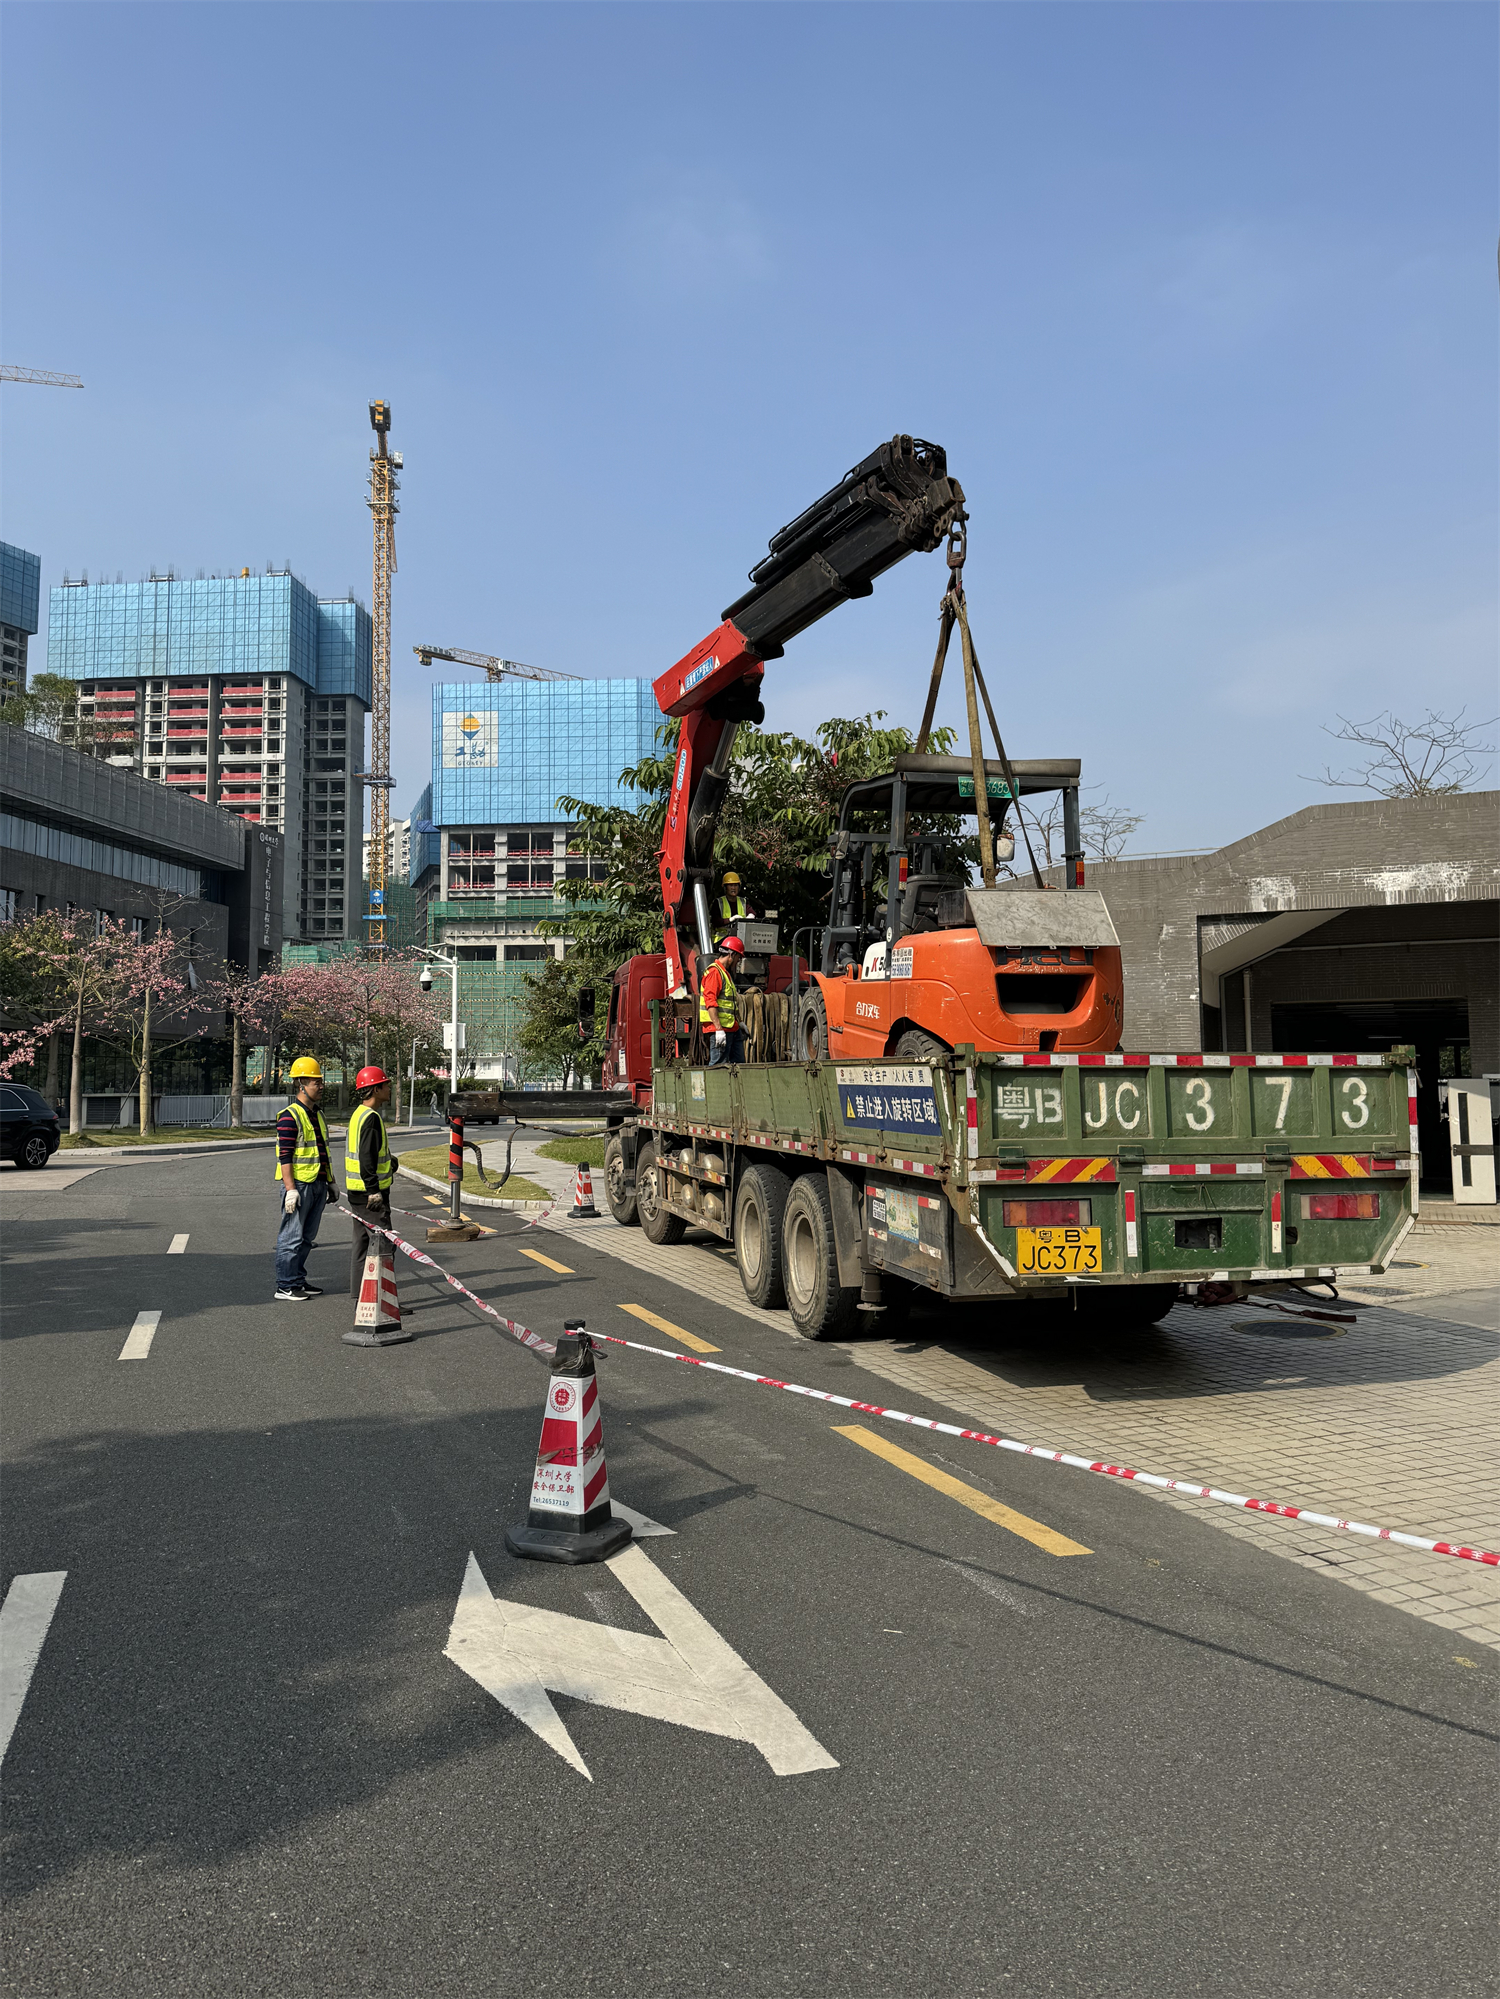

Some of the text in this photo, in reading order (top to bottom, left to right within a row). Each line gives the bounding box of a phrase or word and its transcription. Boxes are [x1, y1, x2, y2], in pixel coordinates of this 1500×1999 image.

[856, 1001, 880, 1019] 合力叉车
[855, 1095, 937, 1124] 禁止进入旋转区域
[994, 1082, 1062, 1129] 粤B
[1022, 1245, 1097, 1270] JC373
[537, 1468, 572, 1483] 深圳大学
[533, 1480, 575, 1495] 安全保卫部
[1448, 1544, 1485, 1562] 安全
